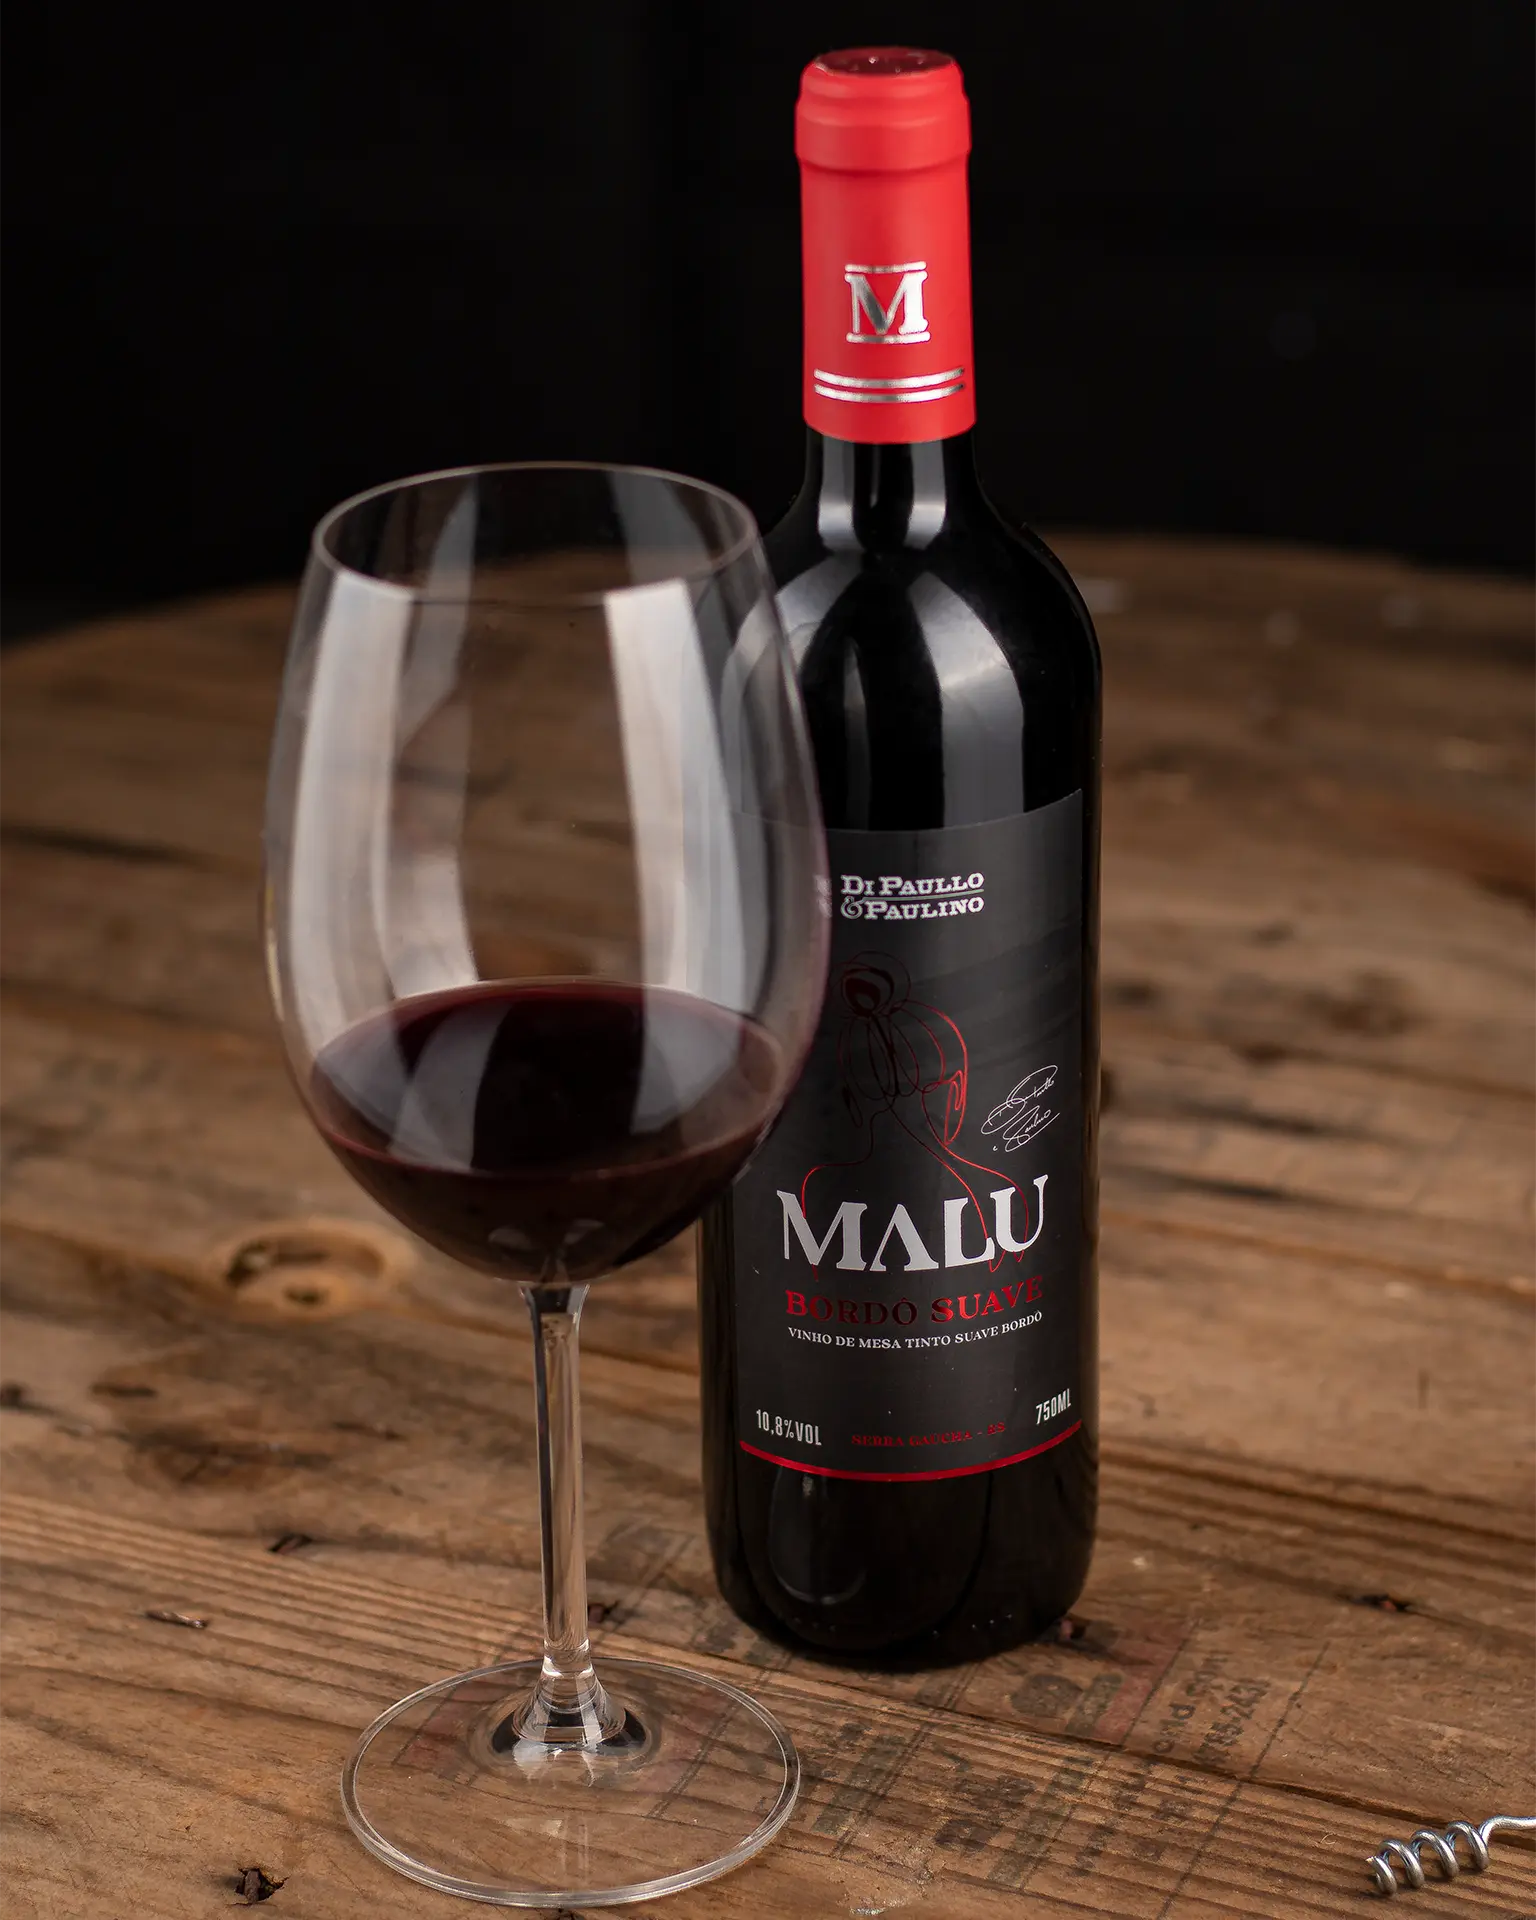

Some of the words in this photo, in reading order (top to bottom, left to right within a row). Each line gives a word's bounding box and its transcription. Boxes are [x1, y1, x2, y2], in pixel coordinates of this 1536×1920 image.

[844, 271, 928, 335] M
[776, 1174, 1049, 1271] MALU
[785, 1289, 918, 1326] BORDÔ
[931, 1275, 1043, 1323] SUAVE
[787, 1327, 832, 1345] VINHO
[835, 1335, 855, 1348] DE
[859, 1338, 902, 1349] MESA
[905, 1335, 951, 1348] TINTO
[955, 1326, 999, 1344] SUAVE
[1036, 1388, 1071, 1425] 750ML
[851, 1434, 904, 1447] SERRA
